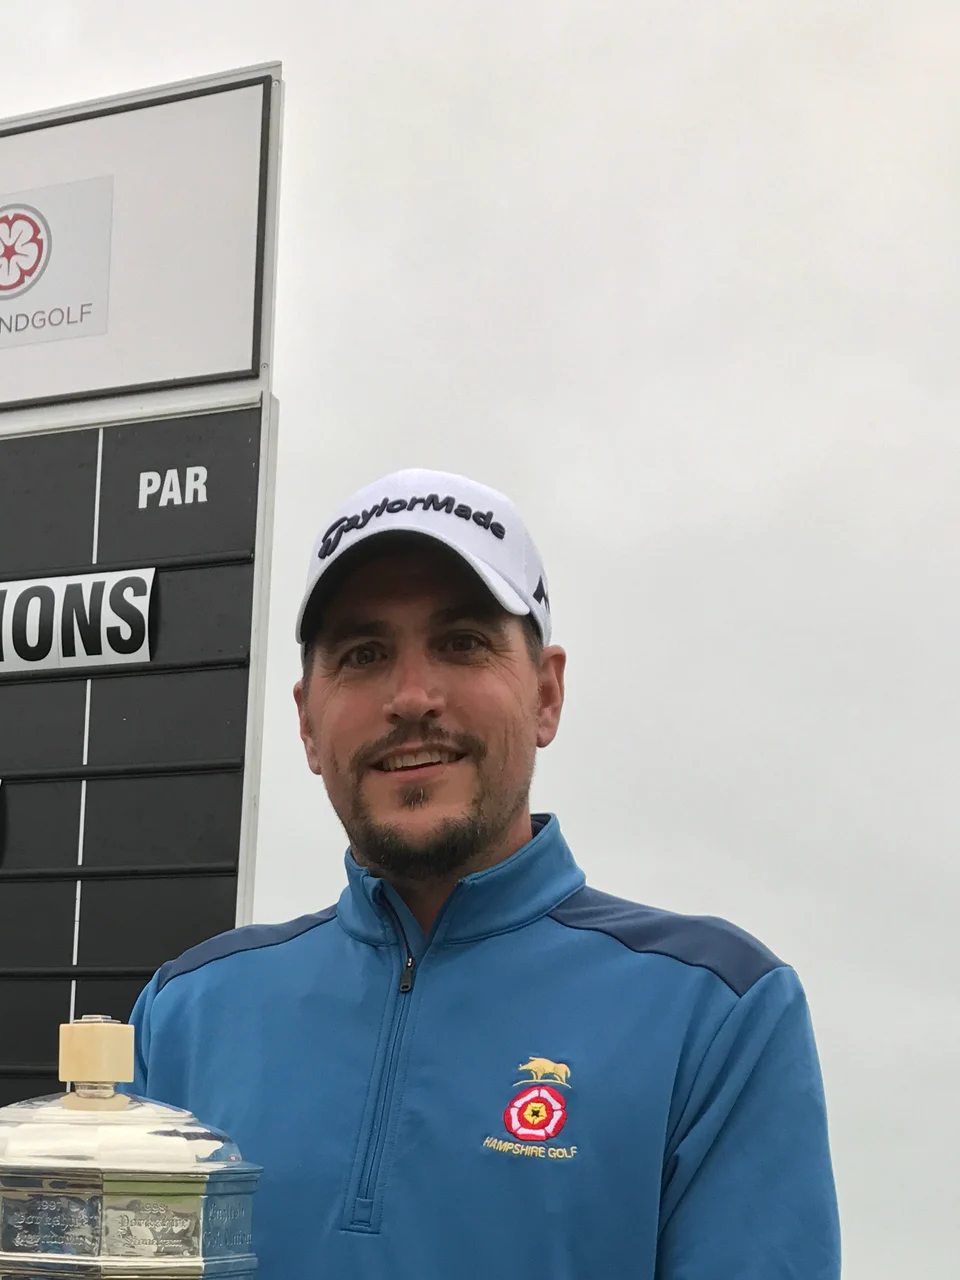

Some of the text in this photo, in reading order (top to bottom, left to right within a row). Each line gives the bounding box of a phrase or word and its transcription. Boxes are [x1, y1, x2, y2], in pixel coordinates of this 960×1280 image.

[139, 465, 209, 508] PAR
[318, 494, 506, 560] TaylorMade
[483, 1136, 578, 1159] HAMPSHIRE GOLF
